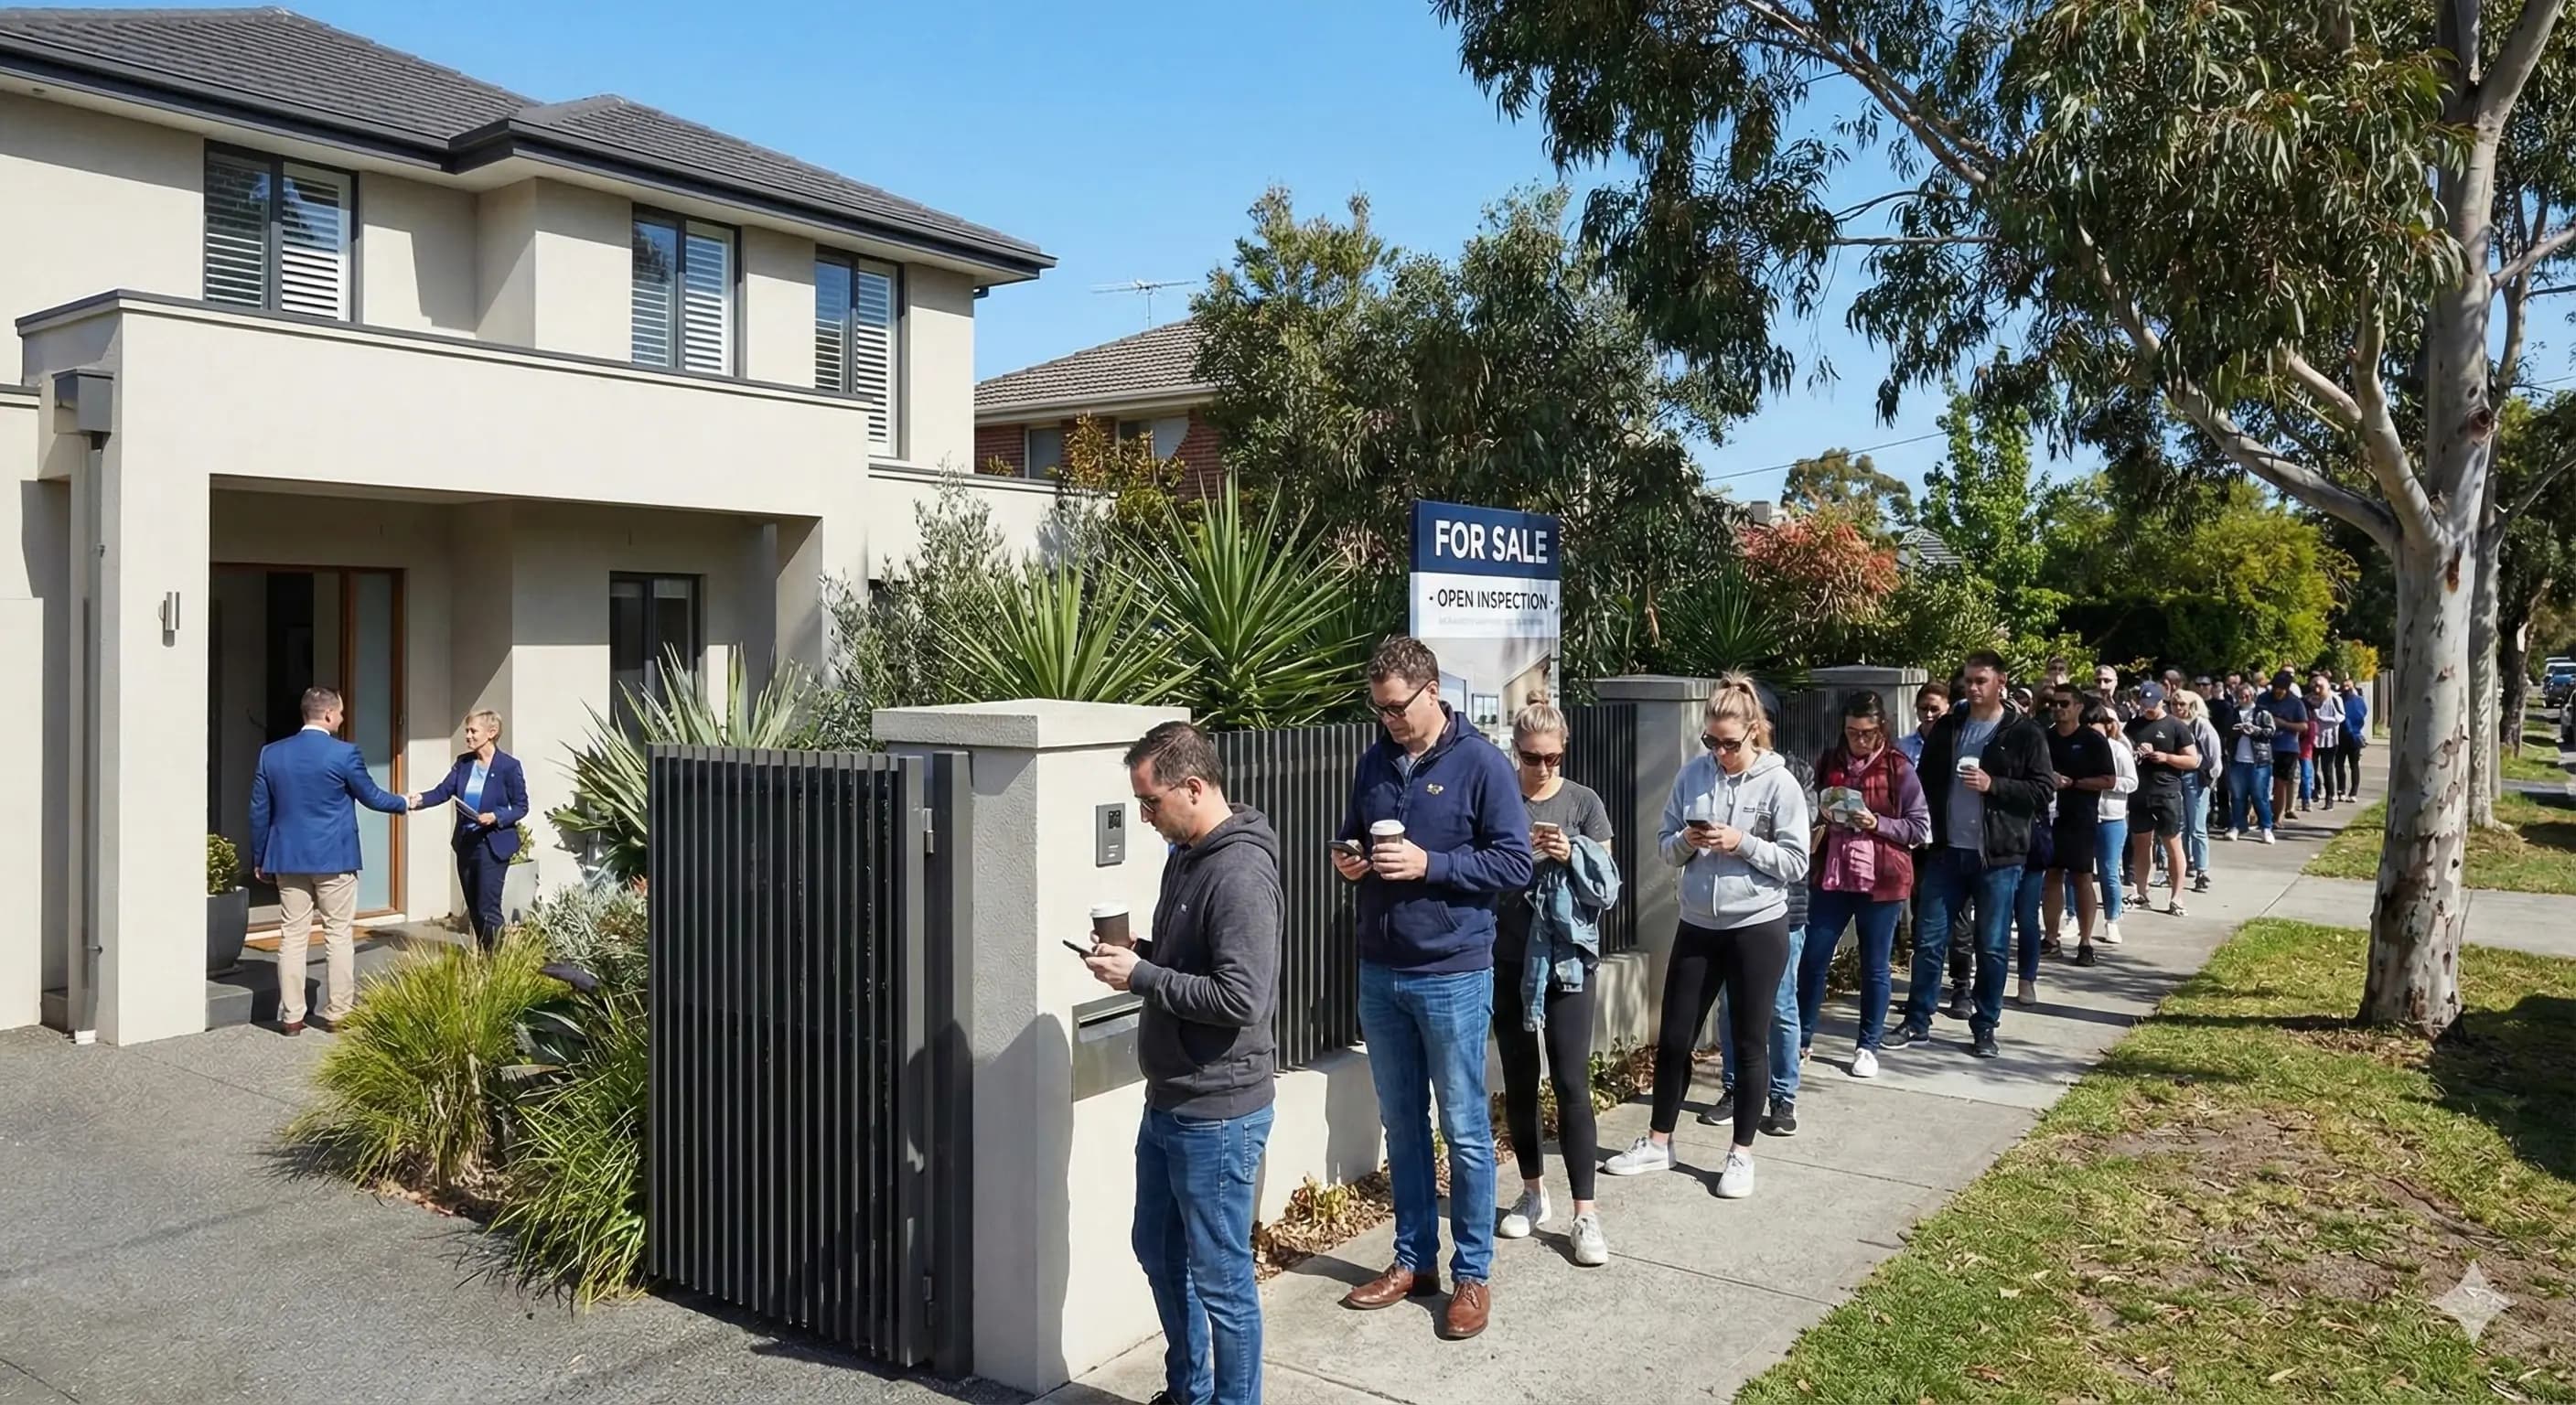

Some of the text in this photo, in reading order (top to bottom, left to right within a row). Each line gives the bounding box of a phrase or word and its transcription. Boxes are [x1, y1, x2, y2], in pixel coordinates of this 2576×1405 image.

[1435, 520, 1548, 563] FOR SALE
[1437, 588, 1548, 611] OPEN INSPECTION
